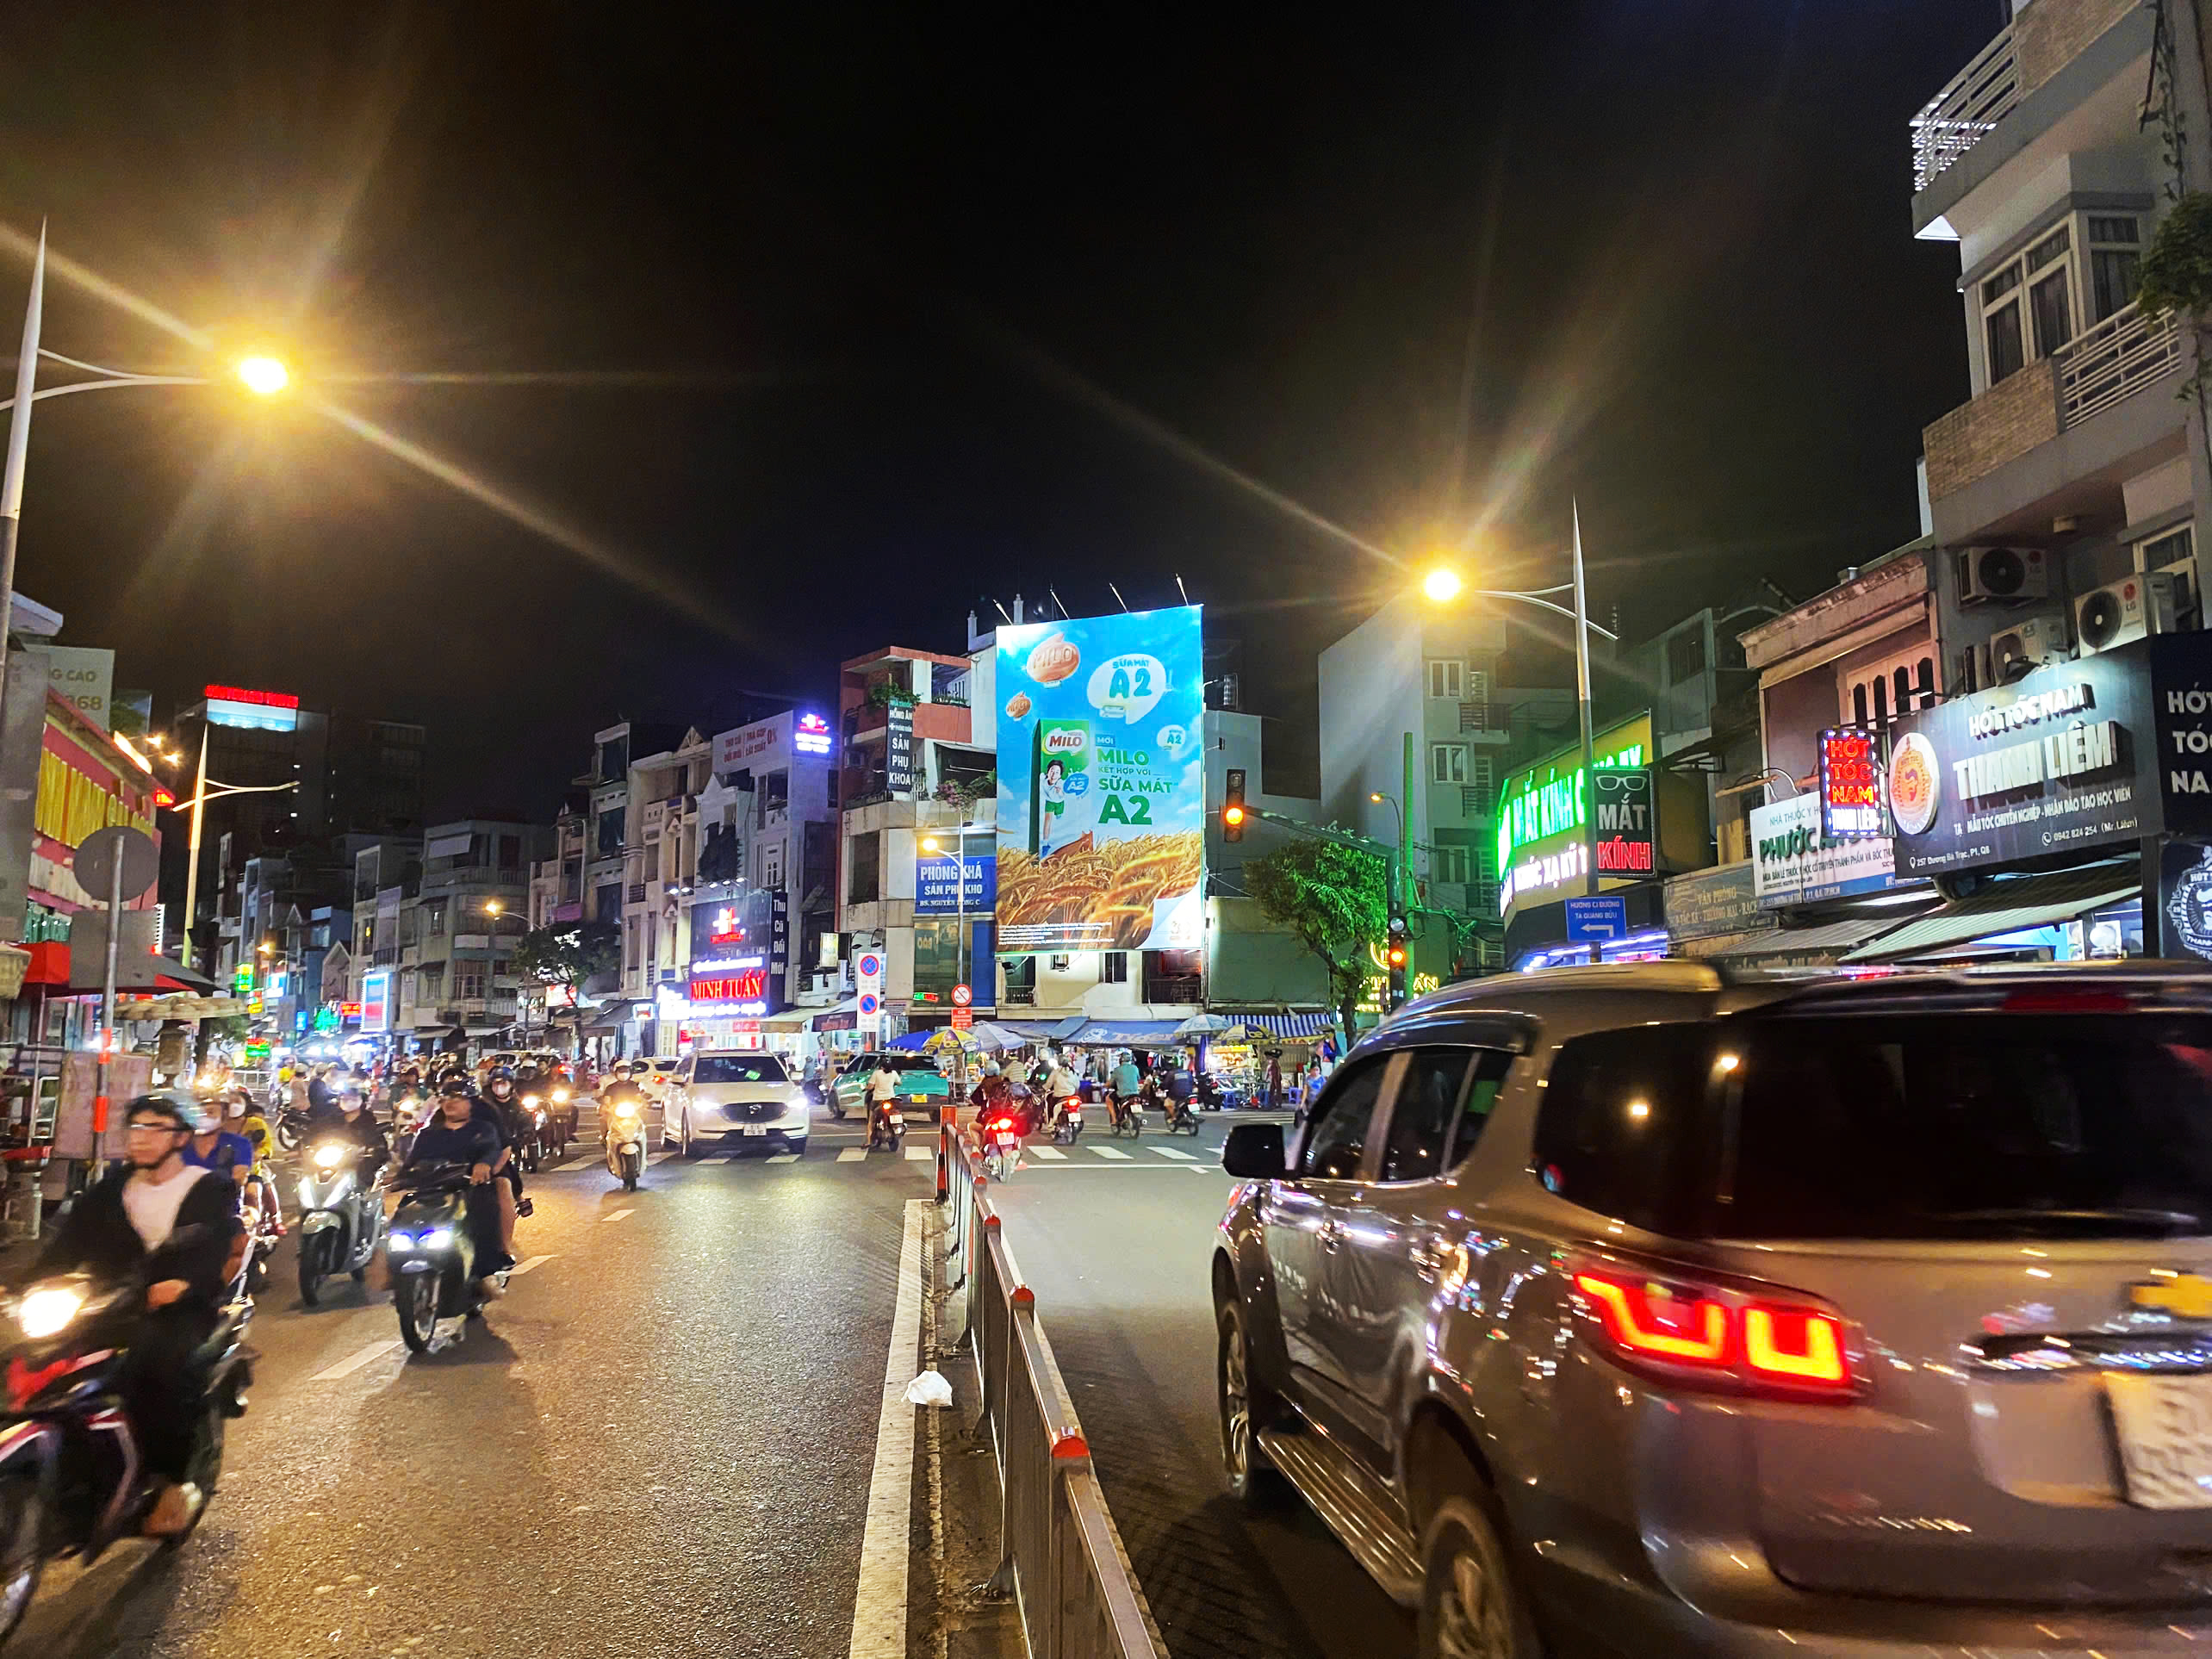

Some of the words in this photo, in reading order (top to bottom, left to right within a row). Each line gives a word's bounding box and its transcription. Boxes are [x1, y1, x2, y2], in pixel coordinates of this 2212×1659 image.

[1034, 647, 1076, 669] MILO
[1109, 668, 1153, 699] A2
[2040, 683, 2090, 717] NAM
[892, 733, 910, 750] SẢN
[1049, 736, 1083, 747] MILO
[1167, 734, 1182, 744] A2
[1830, 736, 1870, 758] HỚT
[2172, 723, 2212, 754] TÓ
[892, 755, 909, 770] PHỤ
[1097, 748, 1150, 766] MILO
[1953, 740, 2044, 800] THANH
[2044, 720, 2117, 780] LIÊM
[889, 772, 911, 786] KHOA
[1830, 759, 1873, 780] TÓC
[1067, 780, 1085, 791] A2
[1098, 774, 1134, 791] SỮA
[1138, 778, 1172, 793] MÁT
[2171, 770, 2212, 793] NA
[1540, 767, 1575, 837] KÍNH
[1832, 786, 1874, 804] NAM
[1098, 794, 1153, 824] A2
[1598, 792, 1646, 830] MẮT
[1769, 813, 1782, 827] NHÀ
[1785, 808, 1805, 824] THUỐC
[1597, 835, 1651, 870] KÍNH
[1759, 824, 1818, 863] PHƯỚC
[920, 861, 958, 881] PHÒNG
[924, 882, 944, 896] SẢN
[774, 899, 786, 912] Thu
[774, 919, 784, 933] Cũ
[692, 980, 723, 1000] MINH
[726, 970, 762, 999] TUẤN
